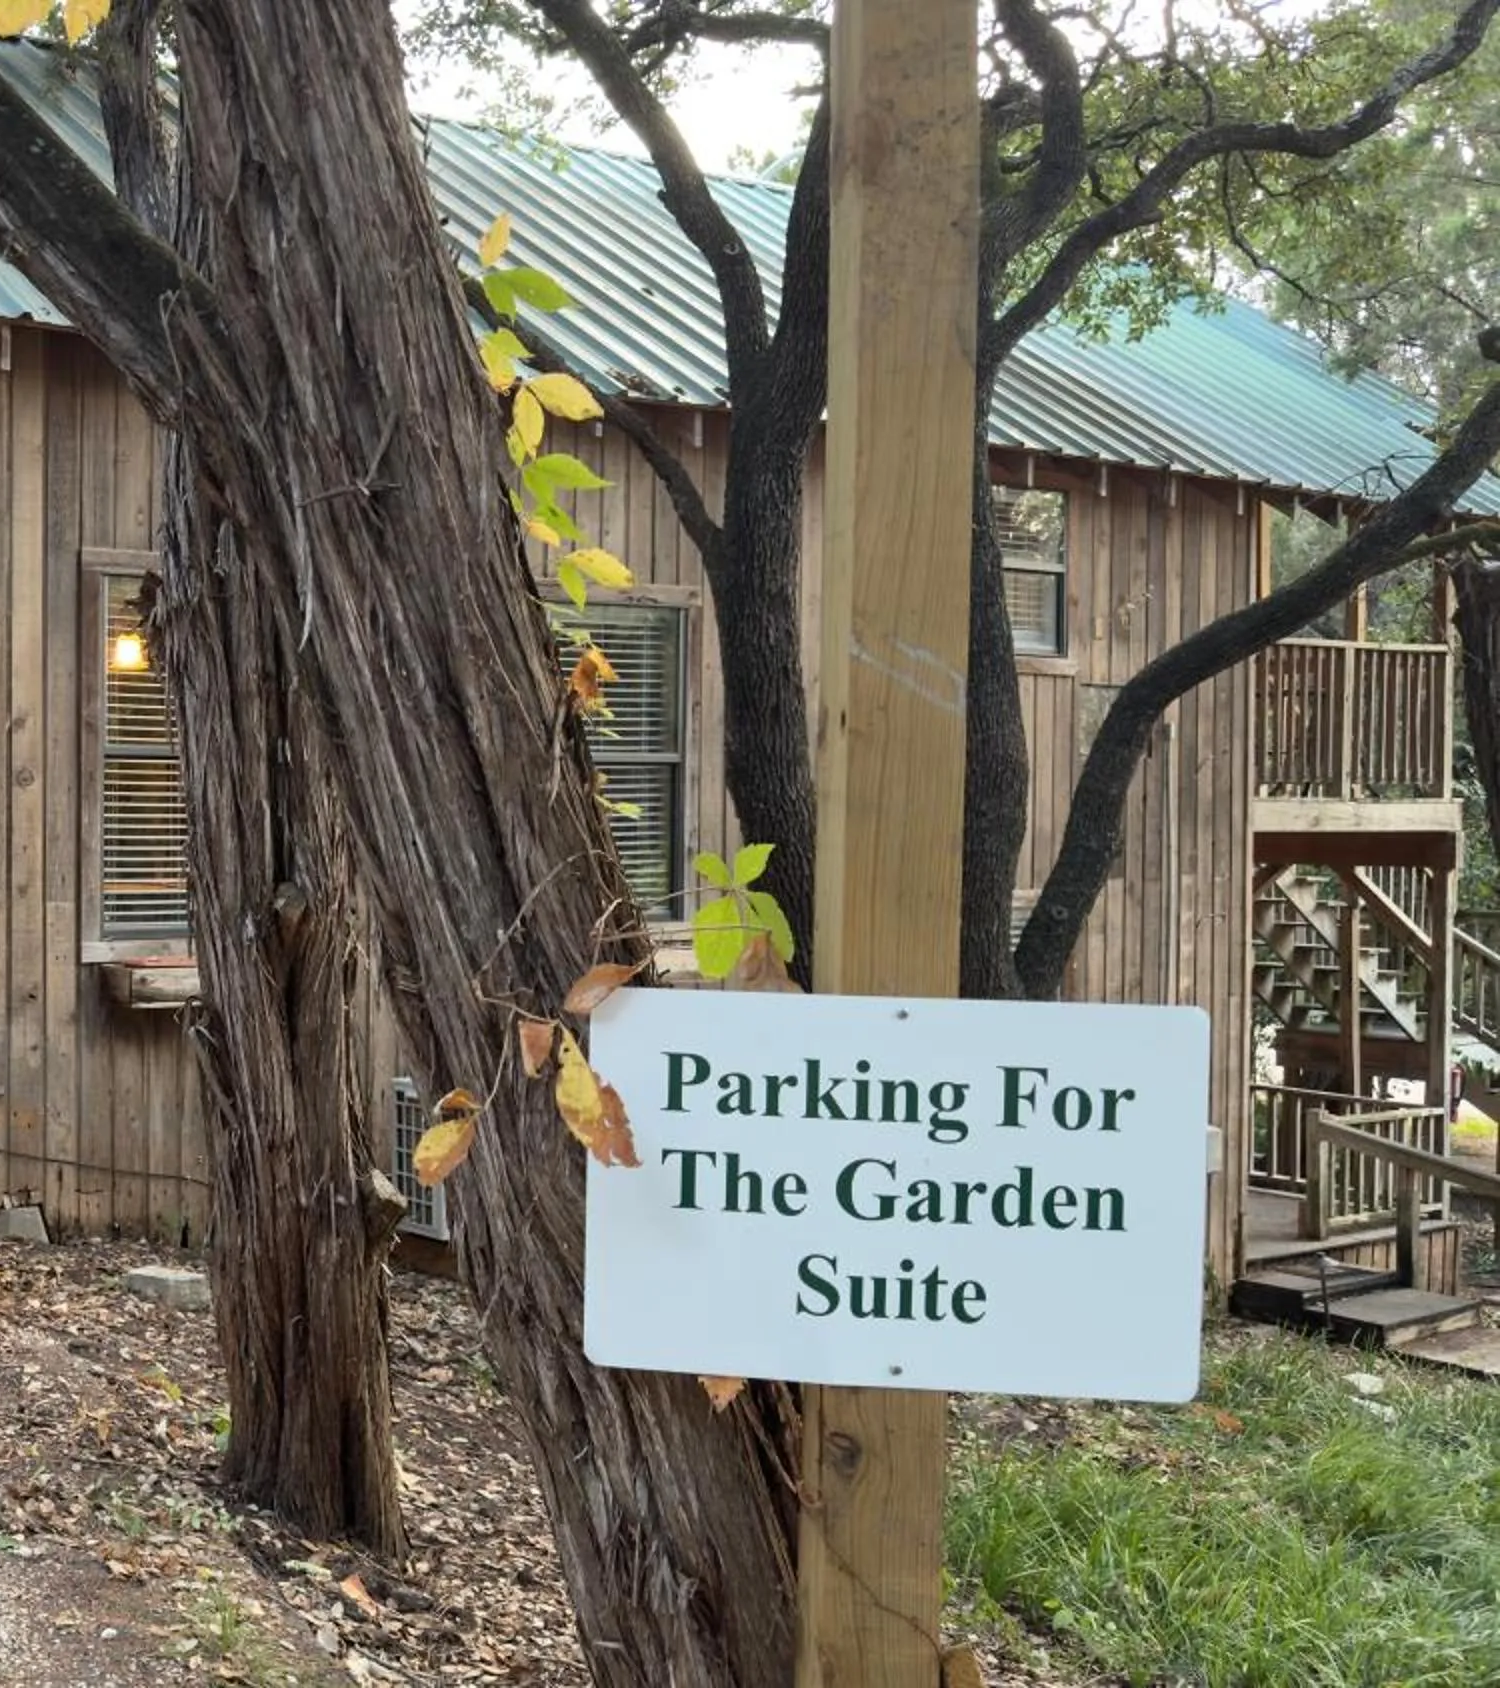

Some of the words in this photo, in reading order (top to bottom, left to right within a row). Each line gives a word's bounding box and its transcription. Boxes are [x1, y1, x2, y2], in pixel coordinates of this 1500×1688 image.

[660, 1051, 971, 1145] Parking
[997, 1065, 1137, 1132] For
[660, 1148, 808, 1218] The
[834, 1158, 1127, 1232] Garden
[795, 1254, 988, 1326] Suite
